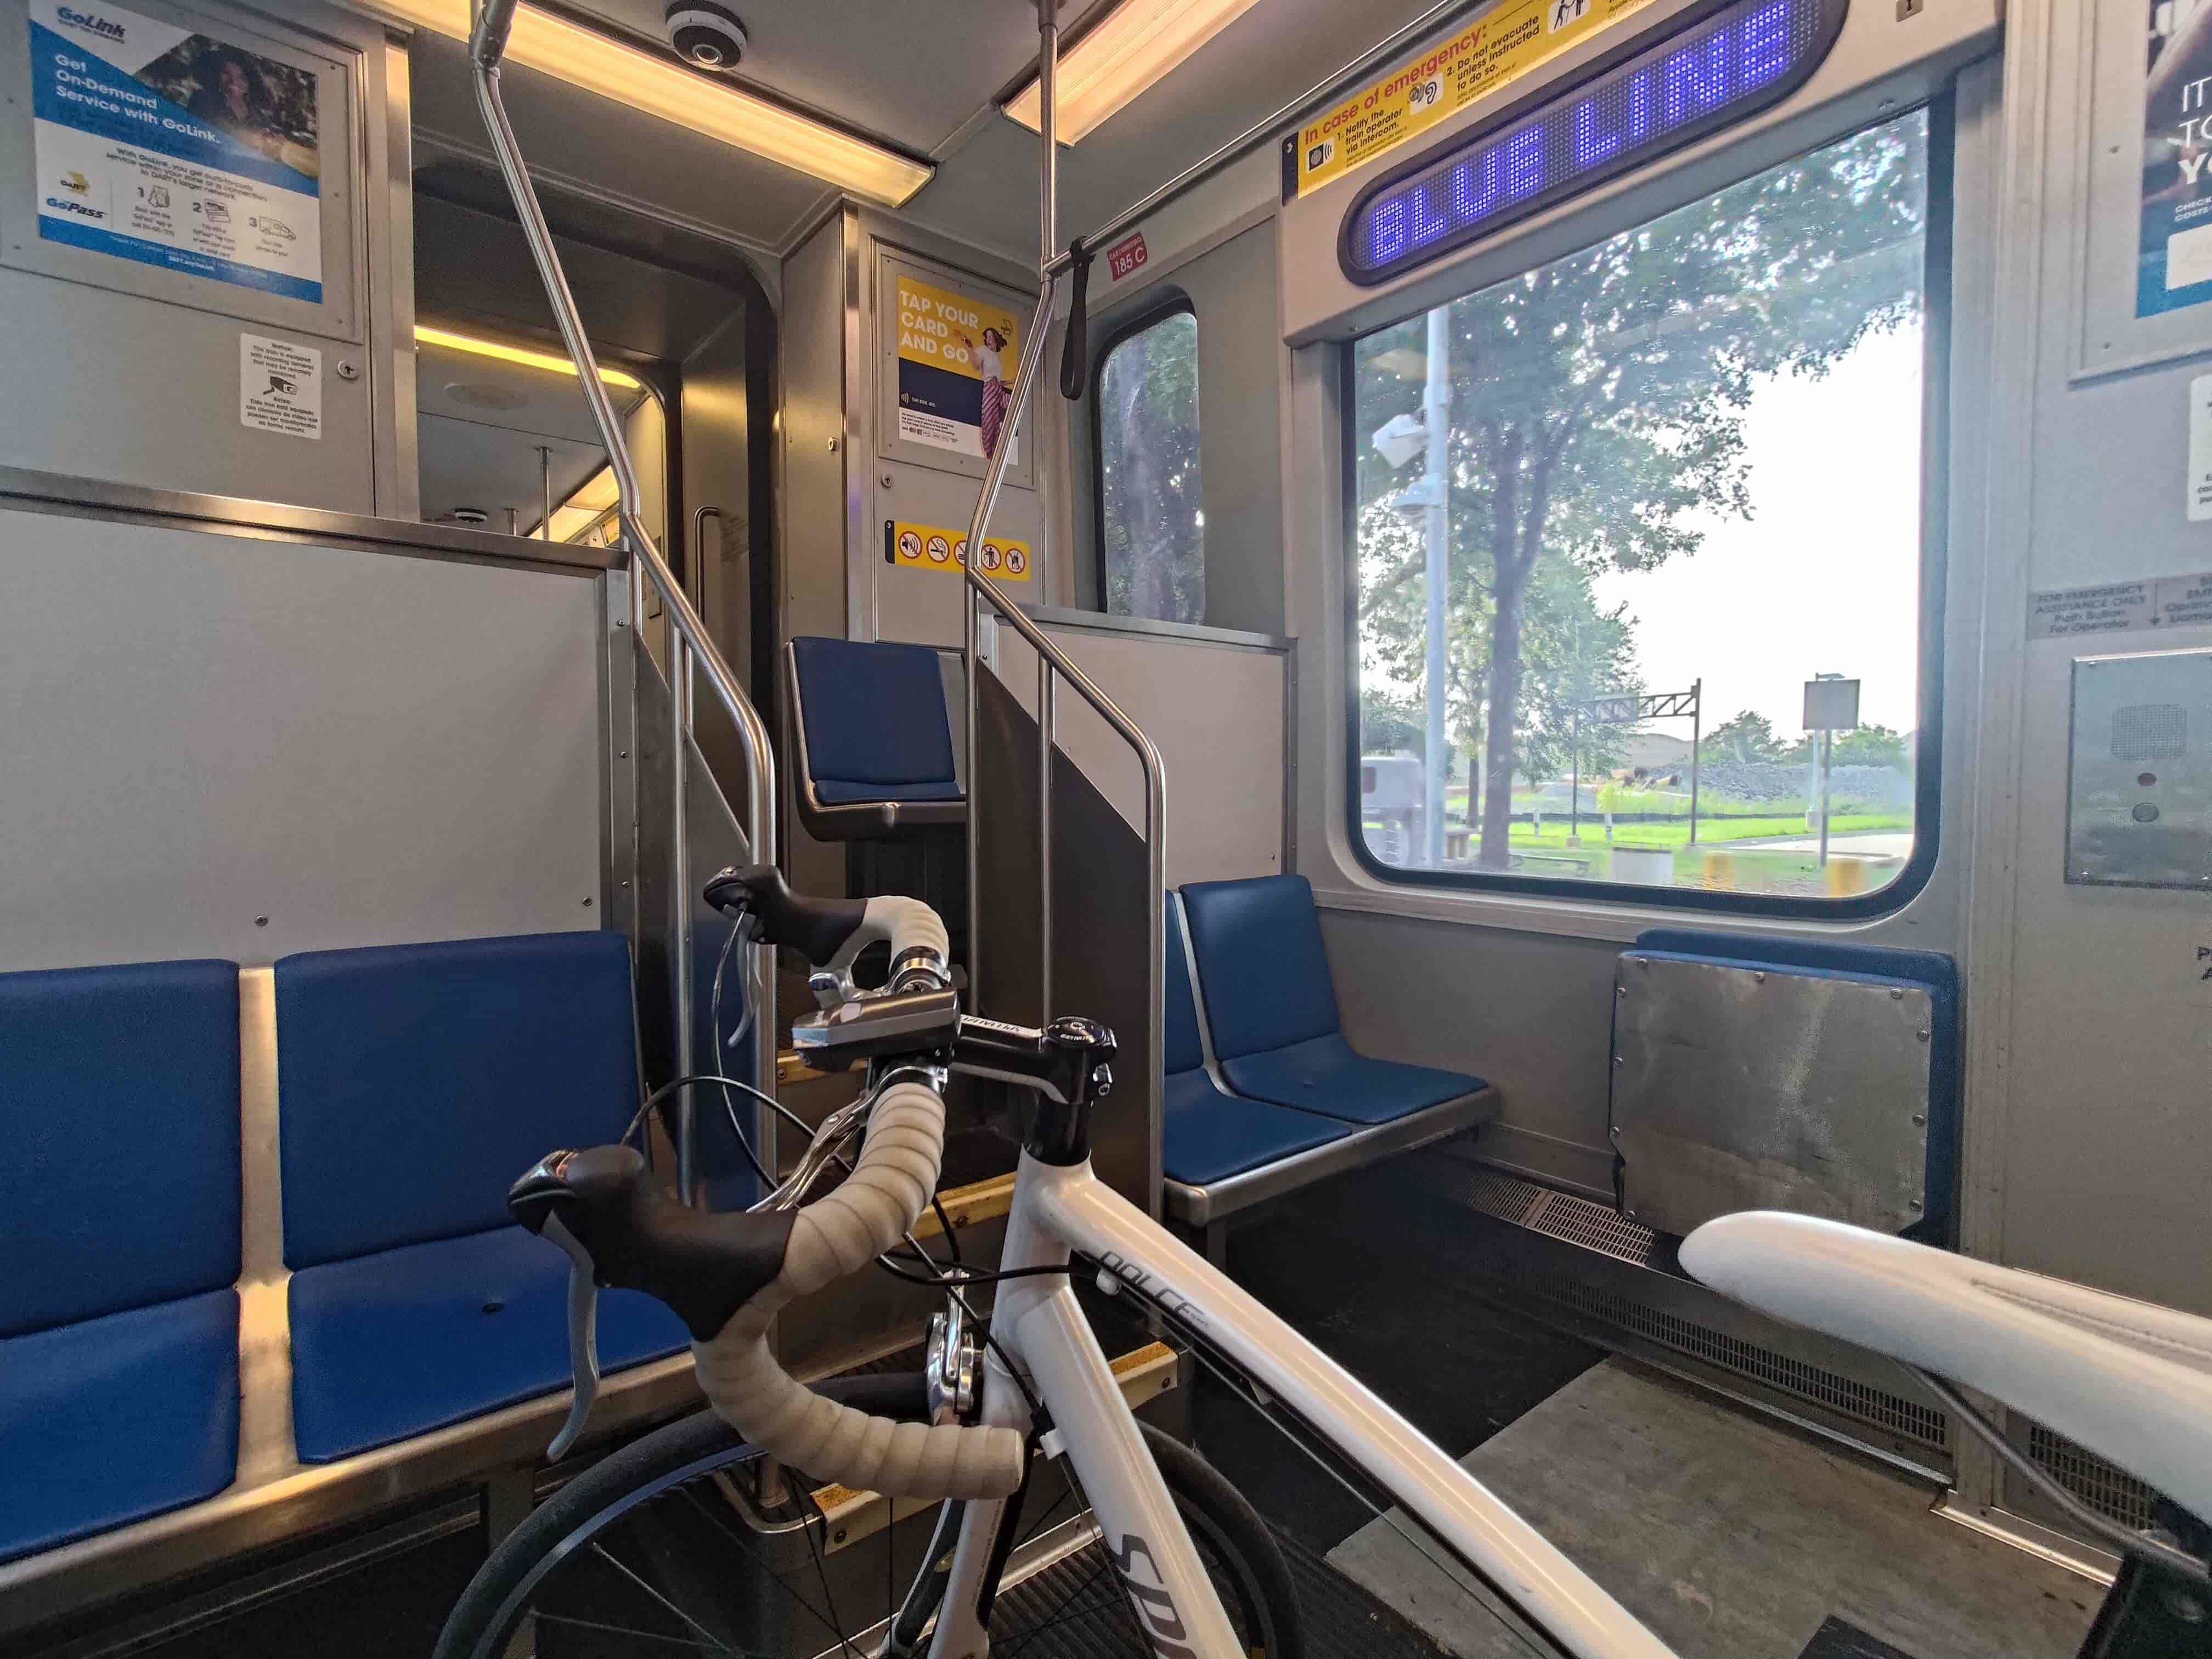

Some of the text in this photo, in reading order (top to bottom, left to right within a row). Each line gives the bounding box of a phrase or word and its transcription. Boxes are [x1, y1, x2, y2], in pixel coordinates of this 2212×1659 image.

[57, 7, 127, 38] GoLink
[1446, 14, 1539, 77] 2. Do not evacuate
[1457, 24, 1540, 81] unless instructed
[55, 53, 87, 72] Get
[1457, 81, 1466, 91] to
[1469, 70, 1482, 84] do
[1484, 62, 1499, 75] so.
[55, 69, 157, 110] On-Demand
[1305, 128, 1318, 146] In
[1322, 103, 1359, 134] case
[1363, 87, 1380, 109] of
[1384, 24, 1487, 98] emergency:
[55, 84, 221, 144] Service with GoLink.
[1345, 116, 1369, 135] Notify
[1370, 109, 1384, 122] the
[1345, 108, 1403, 146] train operator
[1373, 2, 1787, 260] BLUE LINE
[1346, 143, 1358, 155] via
[138, 187, 144, 198] 1
[192, 201, 202, 213] 2
[249, 216, 257, 228] 3
[1114, 246, 1145, 276] 185 C
[900, 290, 979, 330] TAP YOUR
[900, 311, 949, 338] CARD
[900, 330, 969, 364] AND GO
